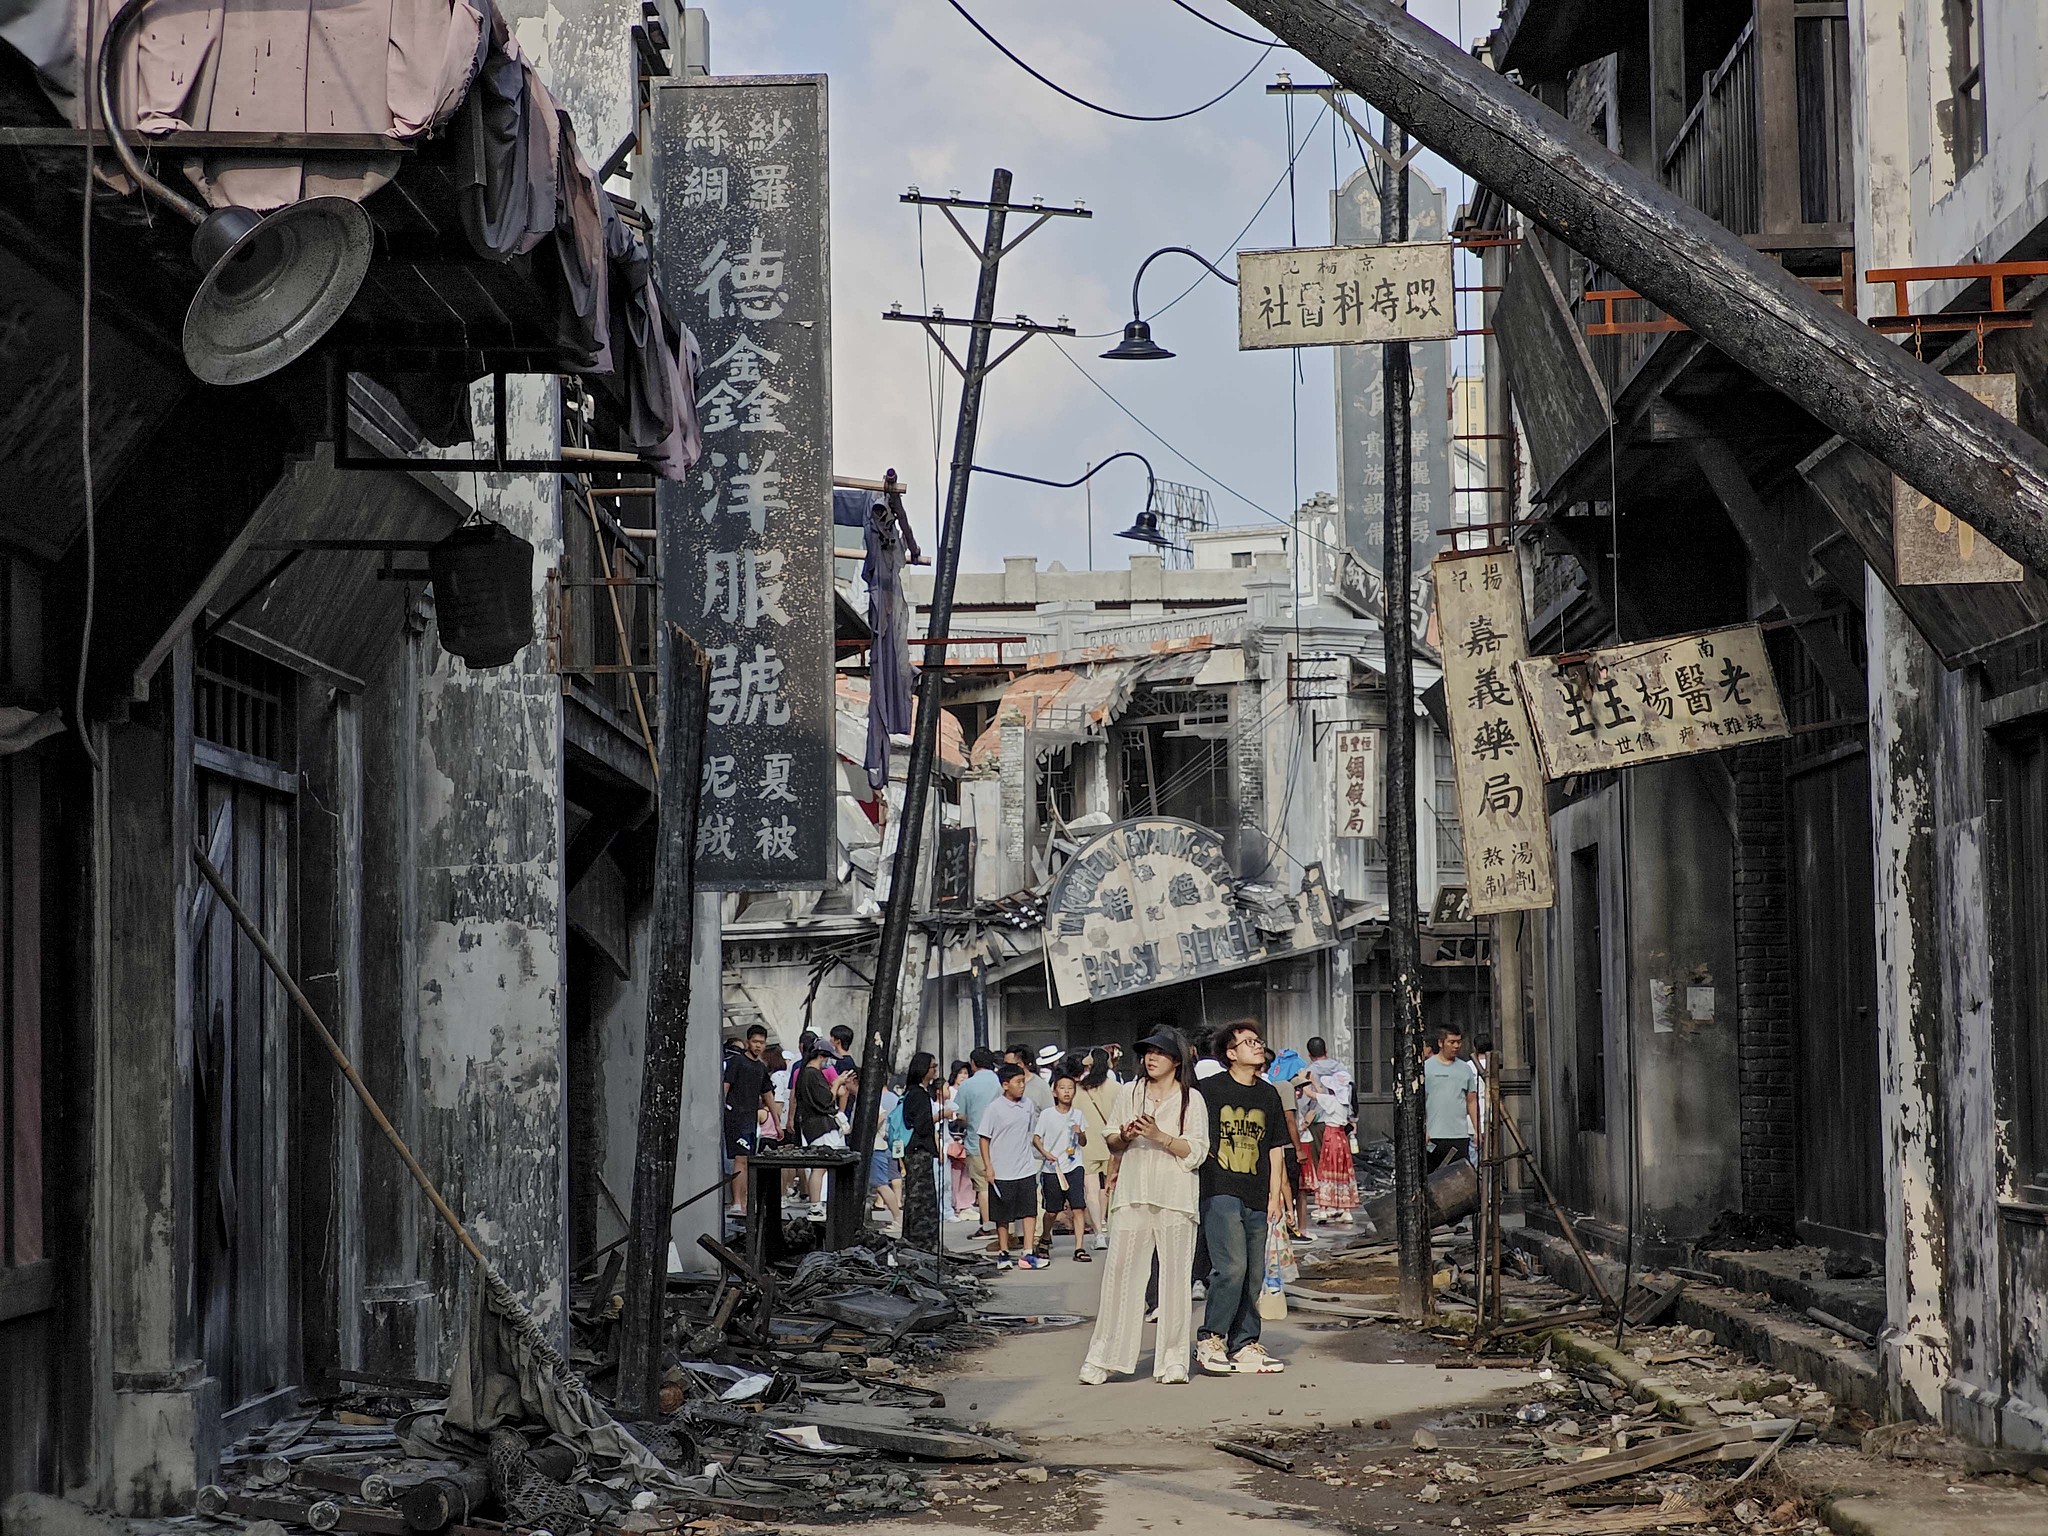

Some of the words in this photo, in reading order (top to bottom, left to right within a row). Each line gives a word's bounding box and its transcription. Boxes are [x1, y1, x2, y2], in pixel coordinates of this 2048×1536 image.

[693, 231, 791, 726] 德鑫洋服號
[755, 754, 799, 861] 夏被
[1459, 615, 1523, 817] 嘉義藥局
